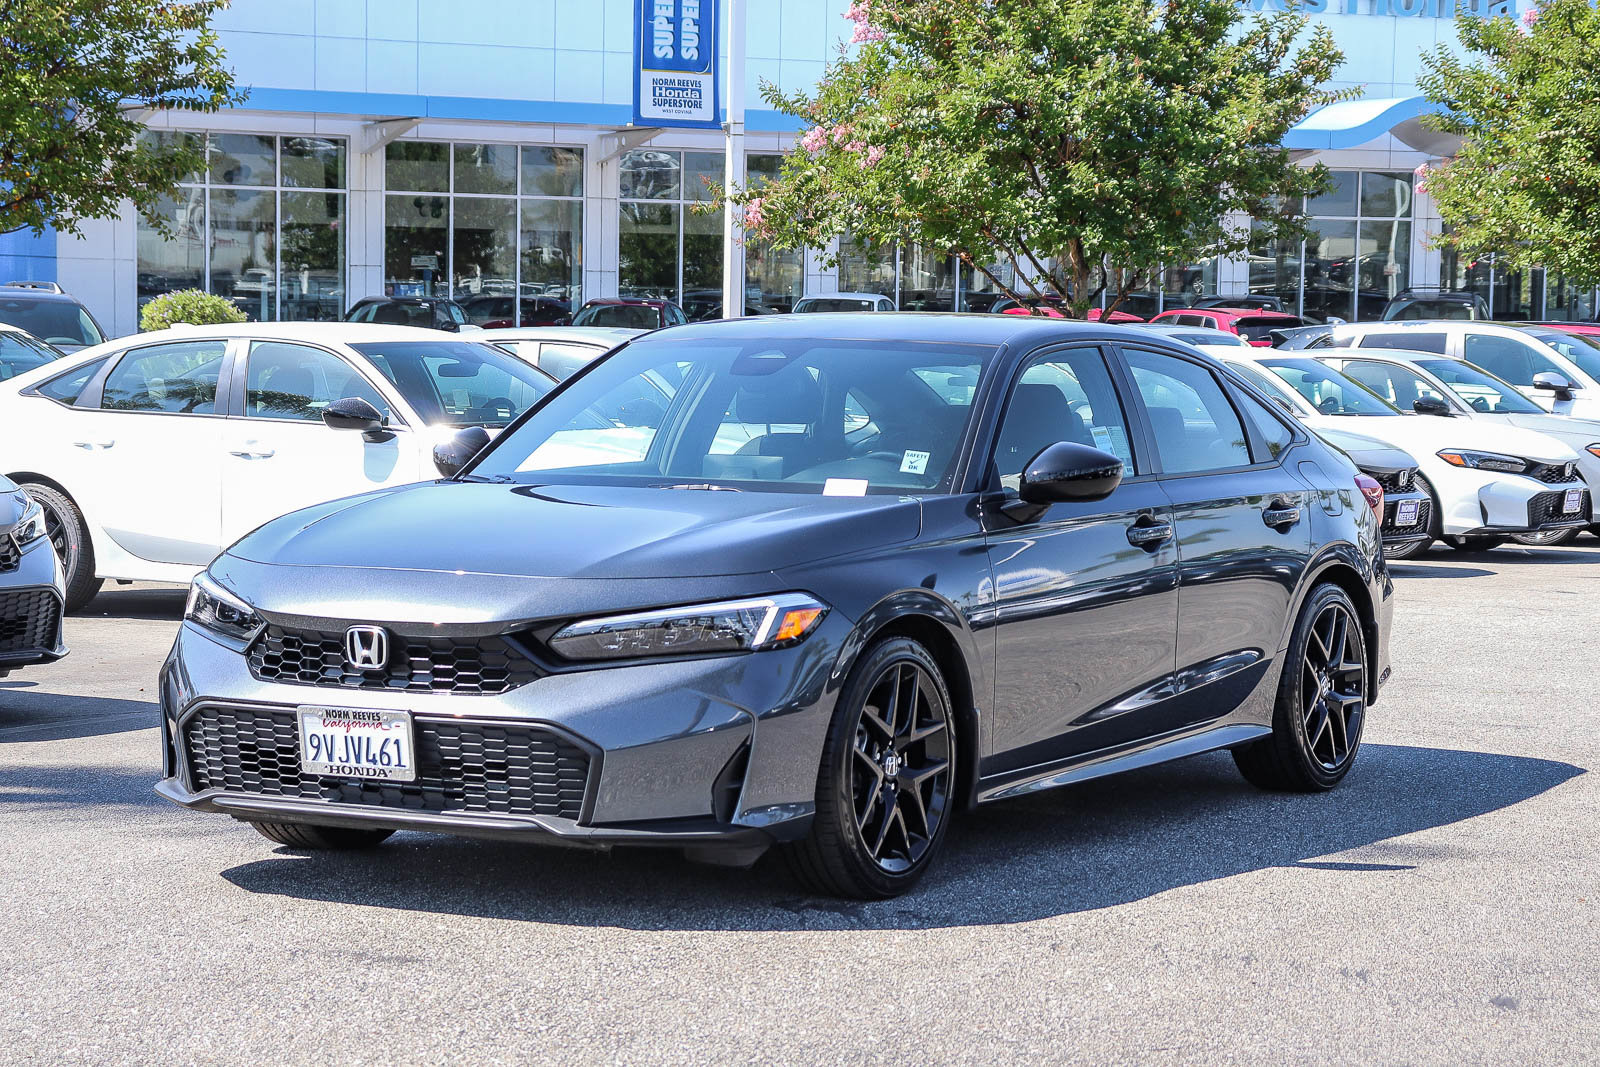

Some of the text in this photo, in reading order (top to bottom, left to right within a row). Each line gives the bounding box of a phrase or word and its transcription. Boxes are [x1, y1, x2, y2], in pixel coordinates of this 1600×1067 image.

[652, 78, 702, 88] NORM REEVES
[655, 86, 700, 99] Honda
[652, 98, 702, 109] SUPERSTORE
[325, 709, 381, 721] NORM REEVES
[309, 733, 406, 767] 9VJV461
[328, 765, 389, 777] HONDA
